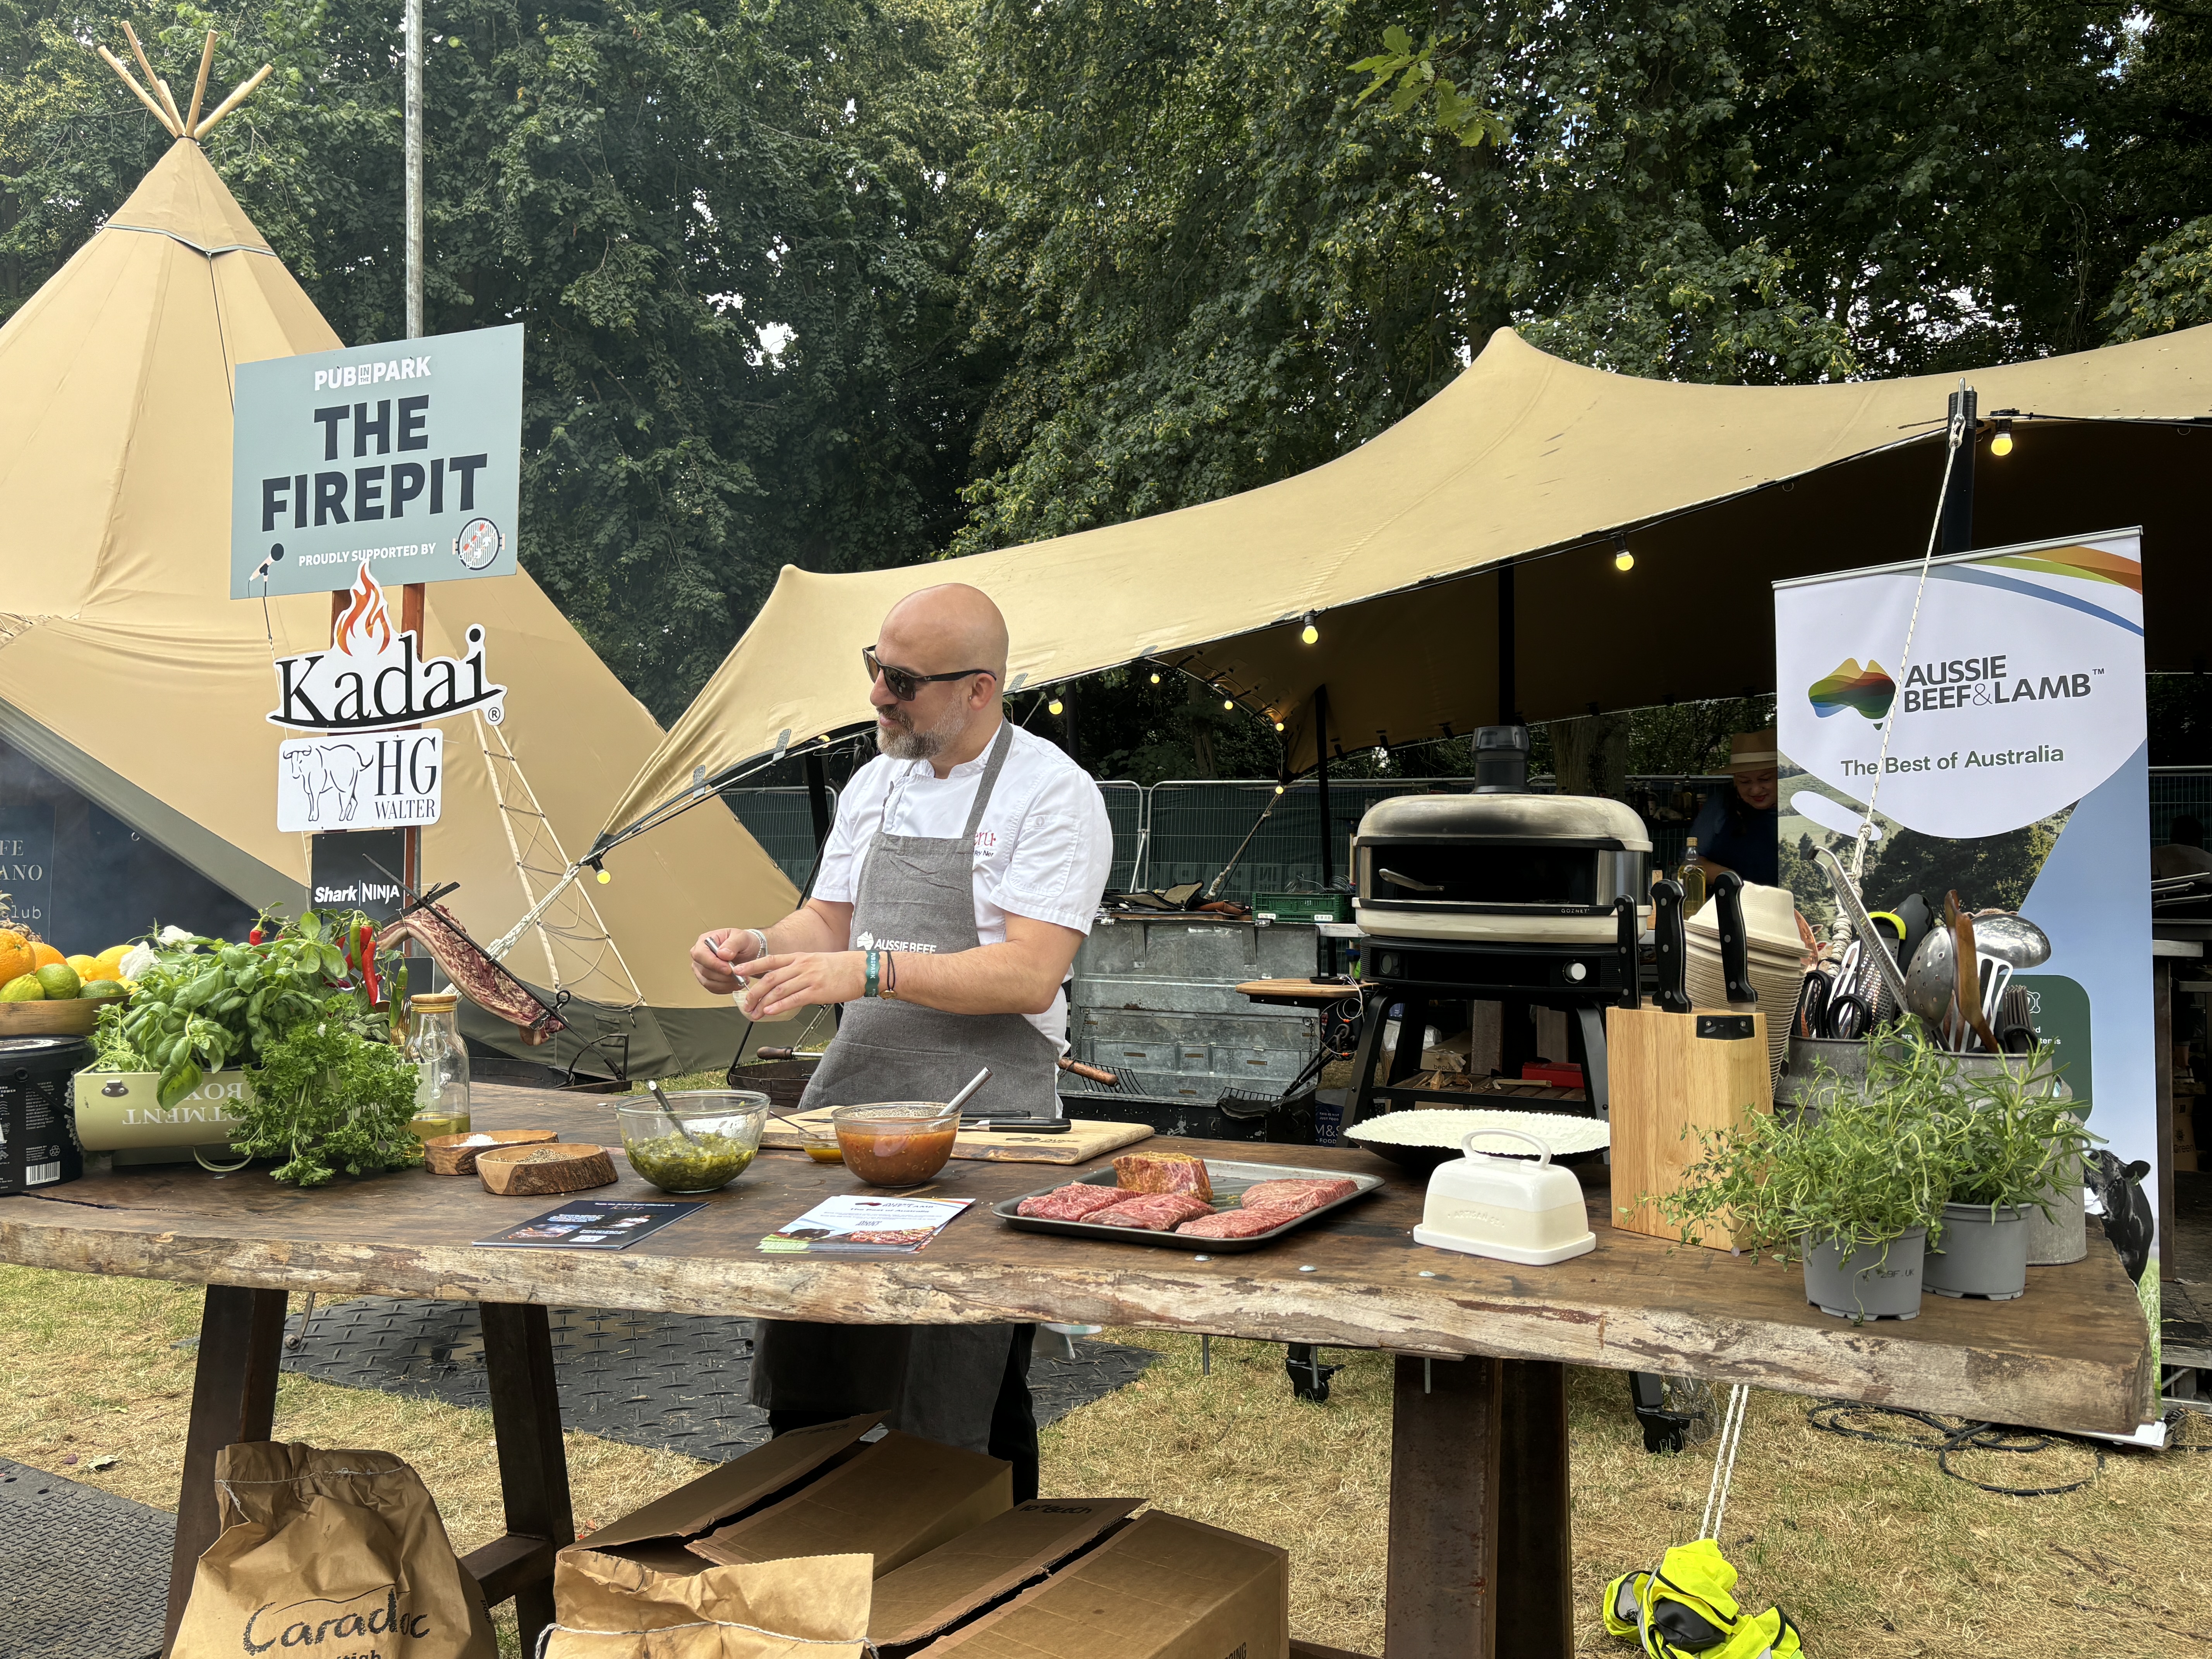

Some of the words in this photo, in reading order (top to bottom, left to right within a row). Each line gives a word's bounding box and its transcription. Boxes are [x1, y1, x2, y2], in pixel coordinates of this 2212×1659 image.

[314, 366, 357, 391] PUB
[360, 366, 370, 376] IN
[373, 356, 432, 383] PARK
[314, 394, 429, 461] THE
[262, 453, 488, 532] FIREPIT
[299, 551, 350, 567] PROUDLY
[351, 544, 418, 562] SUPPORTED
[421, 542, 436, 555] BY
[273, 628, 500, 725] Kadai
[1905, 654, 2006, 687] AUSSIE
[374, 736, 437, 796] HG
[1841, 759, 1879, 776] The
[1885, 756, 1930, 774] Best
[1937, 752, 1958, 769] of
[1964, 744, 2064, 768] Australia
[374, 799, 435, 820] WALTER
[0, 840, 24, 856] FE
[974, 832, 996, 846] eru
[0, 864, 43, 881] ANO
[314, 885, 358, 903] Shark
[362, 882, 400, 905] NINJA
[874, 938, 909, 952] AUSSIE
[910, 942, 937, 954] BEEF
[122, 1106, 247, 1125] TMENT
[242, 1588, 430, 1656] Caradoc
